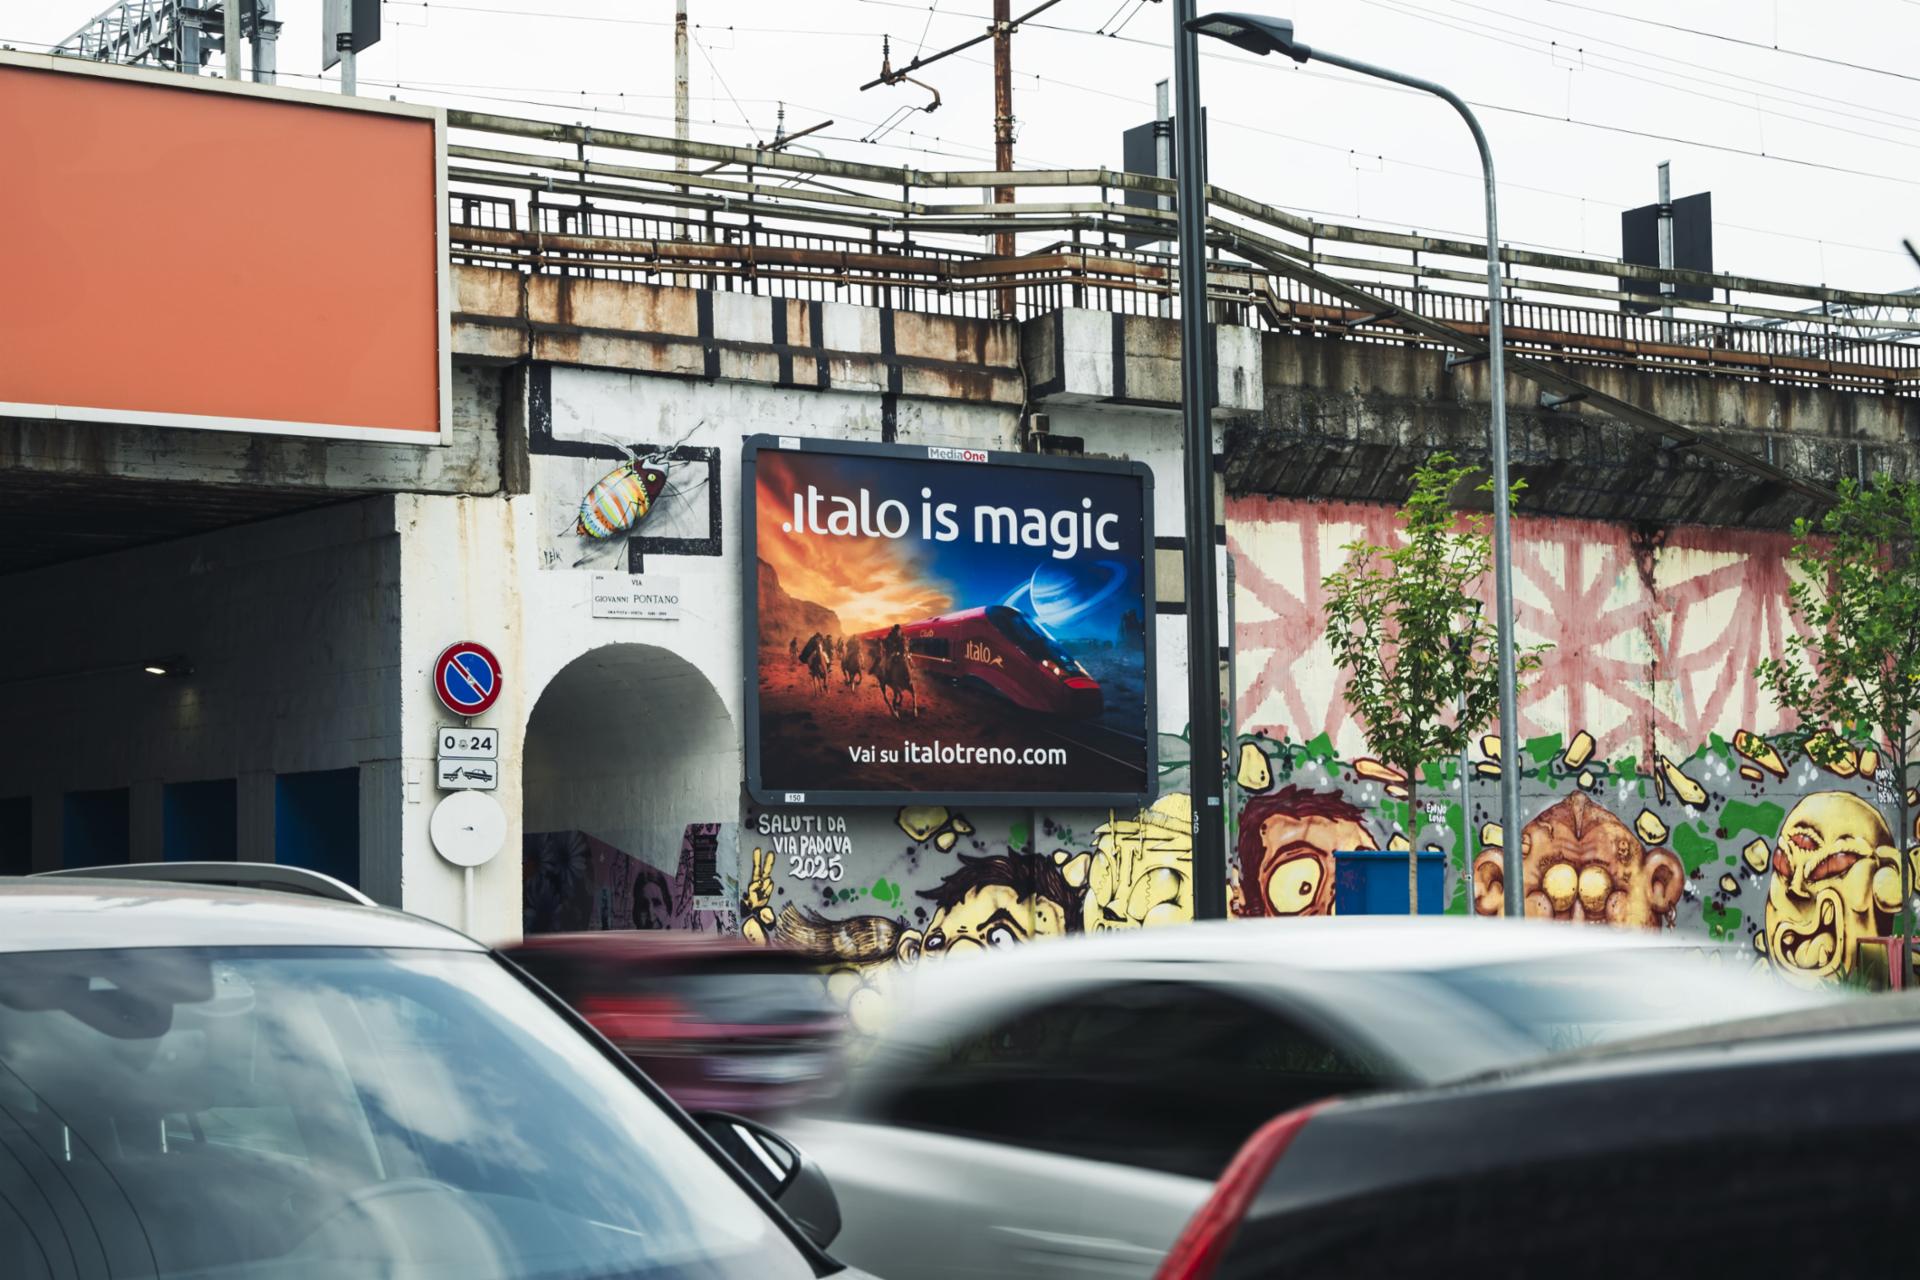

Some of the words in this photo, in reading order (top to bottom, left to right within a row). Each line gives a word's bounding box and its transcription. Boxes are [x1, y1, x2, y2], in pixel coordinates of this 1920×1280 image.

[930, 448, 986, 462] MediaOne
[921, 487, 960, 542] is
[974, 497, 1120, 560] magic
[594, 595, 629, 604] GIOVANNI
[633, 594, 679, 605] PONTANO
[444, 736, 456, 750] 0
[470, 736, 492, 751] 24
[849, 746, 876, 763] Vai
[880, 749, 898, 763] su
[904, 740, 1067, 765] italotreno.com
[788, 794, 801, 802] 150
[759, 813, 822, 834] SALUTI
[827, 816, 846, 833] DA
[773, 836, 797, 855] VIA
[800, 835, 852, 857] PADOVA
[788, 854, 844, 881] 2025
